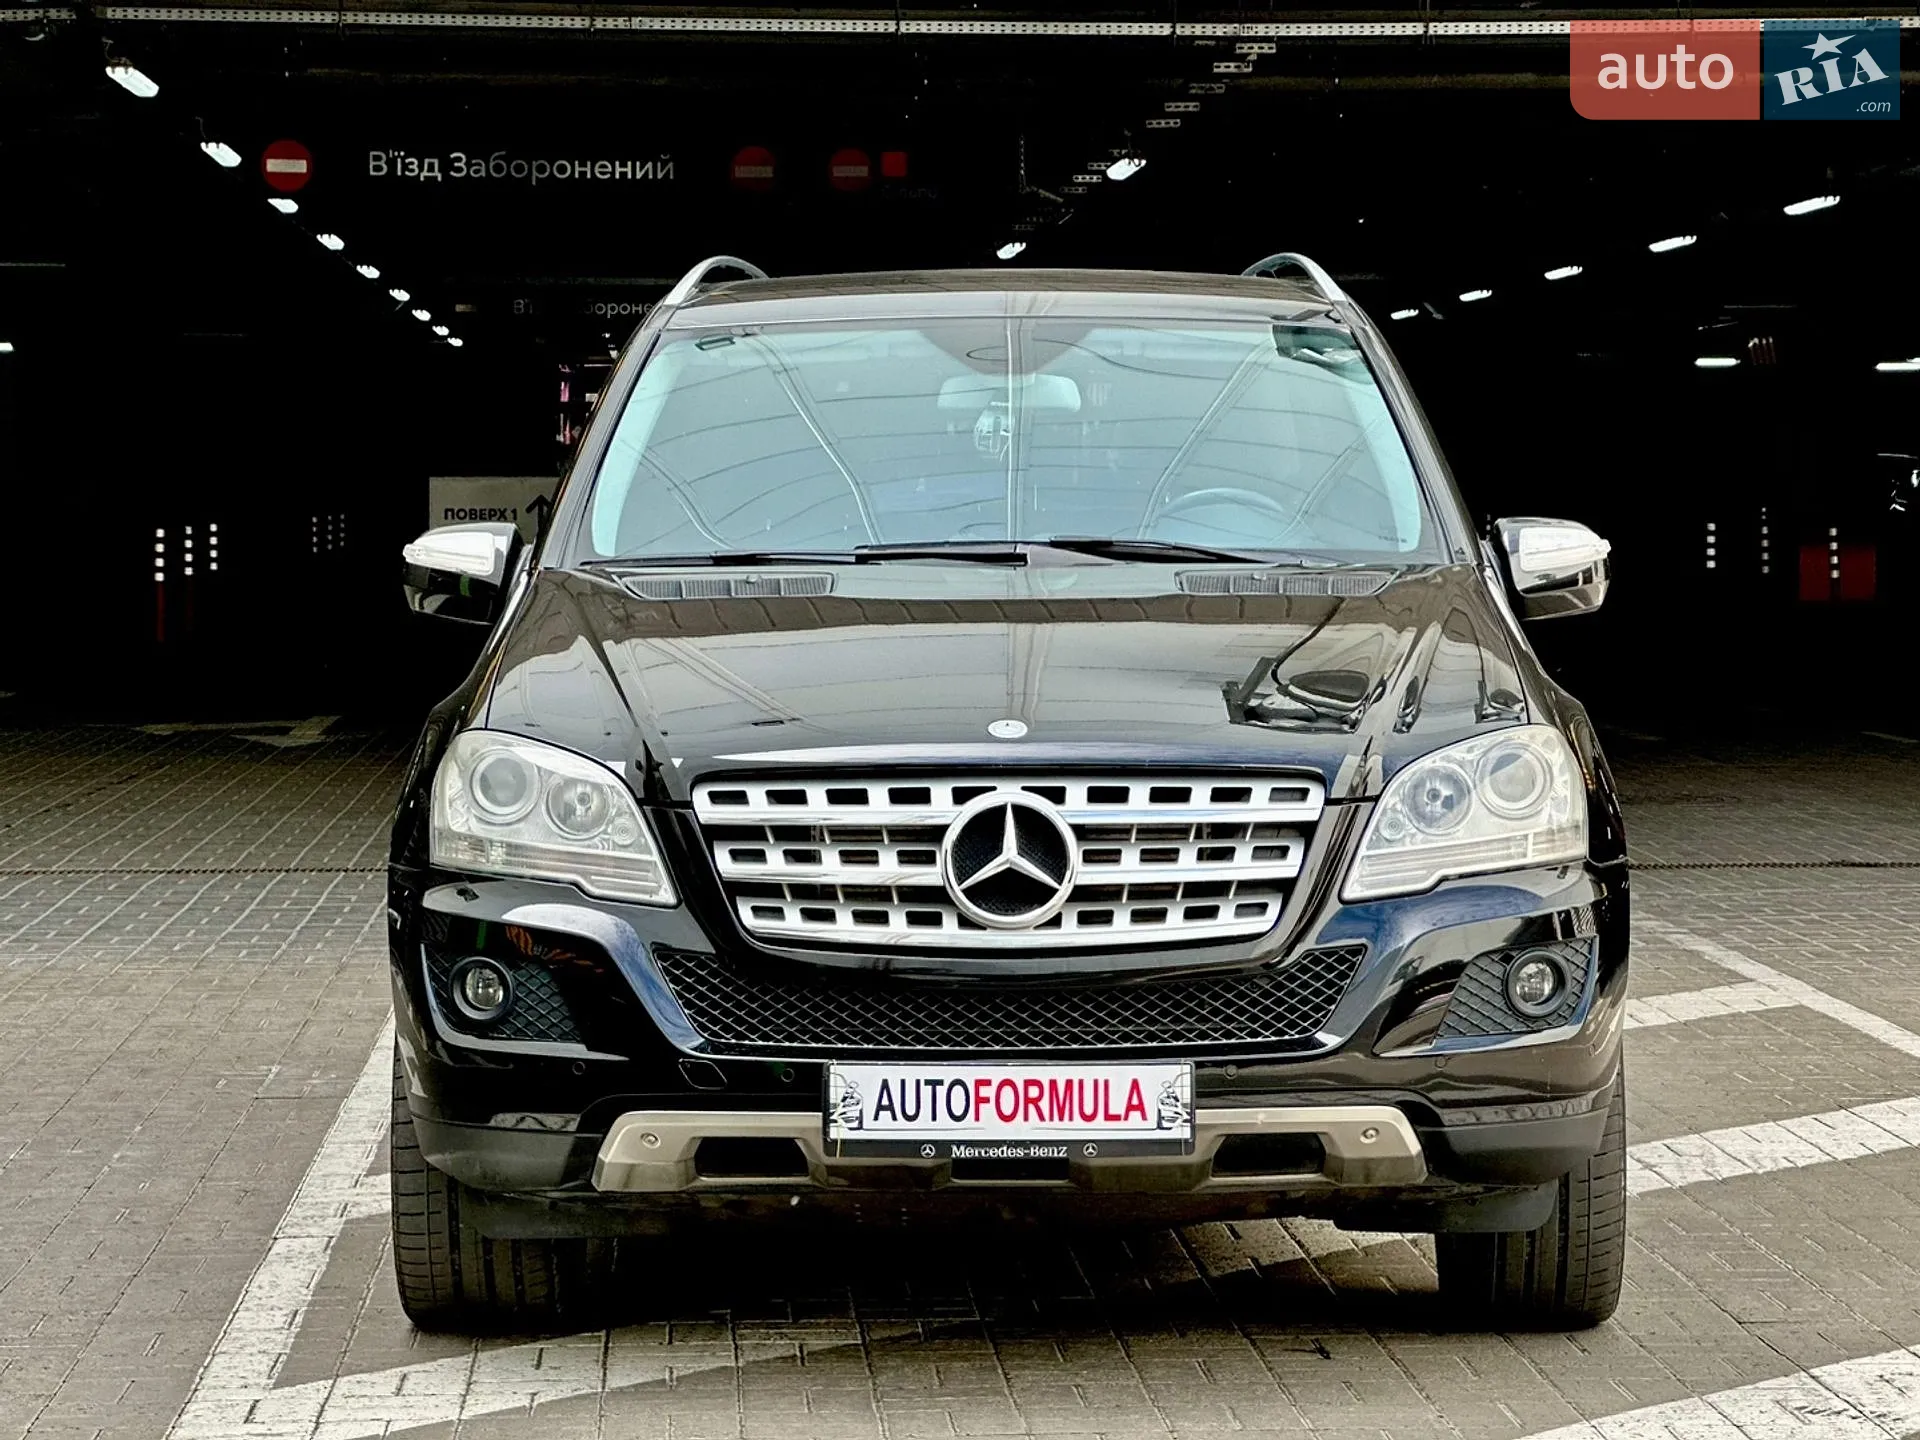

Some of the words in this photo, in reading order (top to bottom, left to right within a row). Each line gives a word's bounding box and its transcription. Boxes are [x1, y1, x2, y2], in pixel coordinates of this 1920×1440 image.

[449, 151, 676, 186] Заборонений
[444, 508, 508, 521] ПОВЕРХ
[511, 508, 518, 521] 1
[872, 1077, 1149, 1123] AUTOFORMULA
[950, 1144, 1068, 1158] Mercedes-Benz
